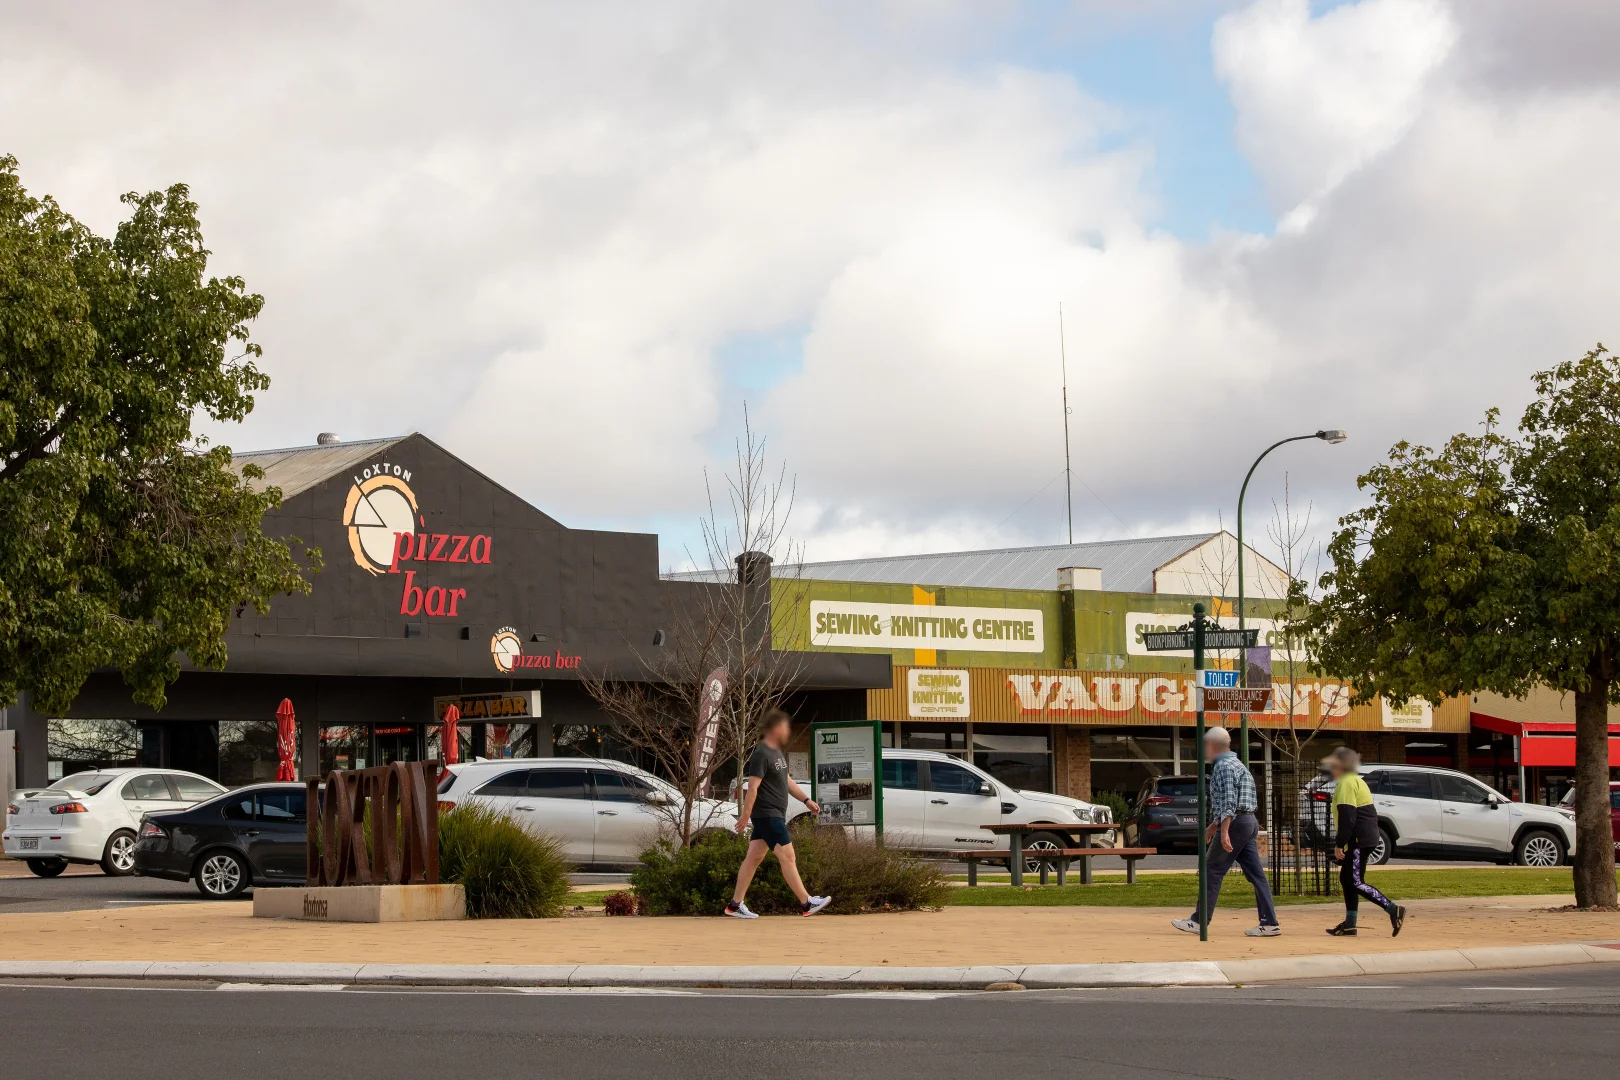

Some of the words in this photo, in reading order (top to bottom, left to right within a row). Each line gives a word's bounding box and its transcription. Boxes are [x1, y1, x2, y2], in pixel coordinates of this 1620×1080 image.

[354, 461, 412, 486] LOXTON
[388, 515, 491, 574] pizza
[400, 570, 467, 617] bar
[494, 626, 517, 637] LOXTON
[815, 612, 881, 635] SEWING
[891, 615, 968, 639] KNITTING
[972, 618, 1035, 641] CENTRE
[1147, 634, 1186, 649] BOOKPURNONG
[1204, 632, 1245, 647] BOOKPURNONG
[511, 647, 551, 672] pizza
[555, 649, 582, 669] bar
[917, 674, 961, 687] SEWING
[1208, 672, 1234, 686] TOILET
[912, 691, 964, 704] KNITTING
[1007, 674, 1351, 724] VAUGN'S
[1207, 689, 1263, 701] COUNTERBALANCE
[437, 700, 489, 720] PZZA
[490, 696, 528, 717] BAR
[1217, 700, 1253, 712] SCULPTURE
[304, 759, 440, 886] LOXTON
[954, 837, 994, 845] WILDTRAK
